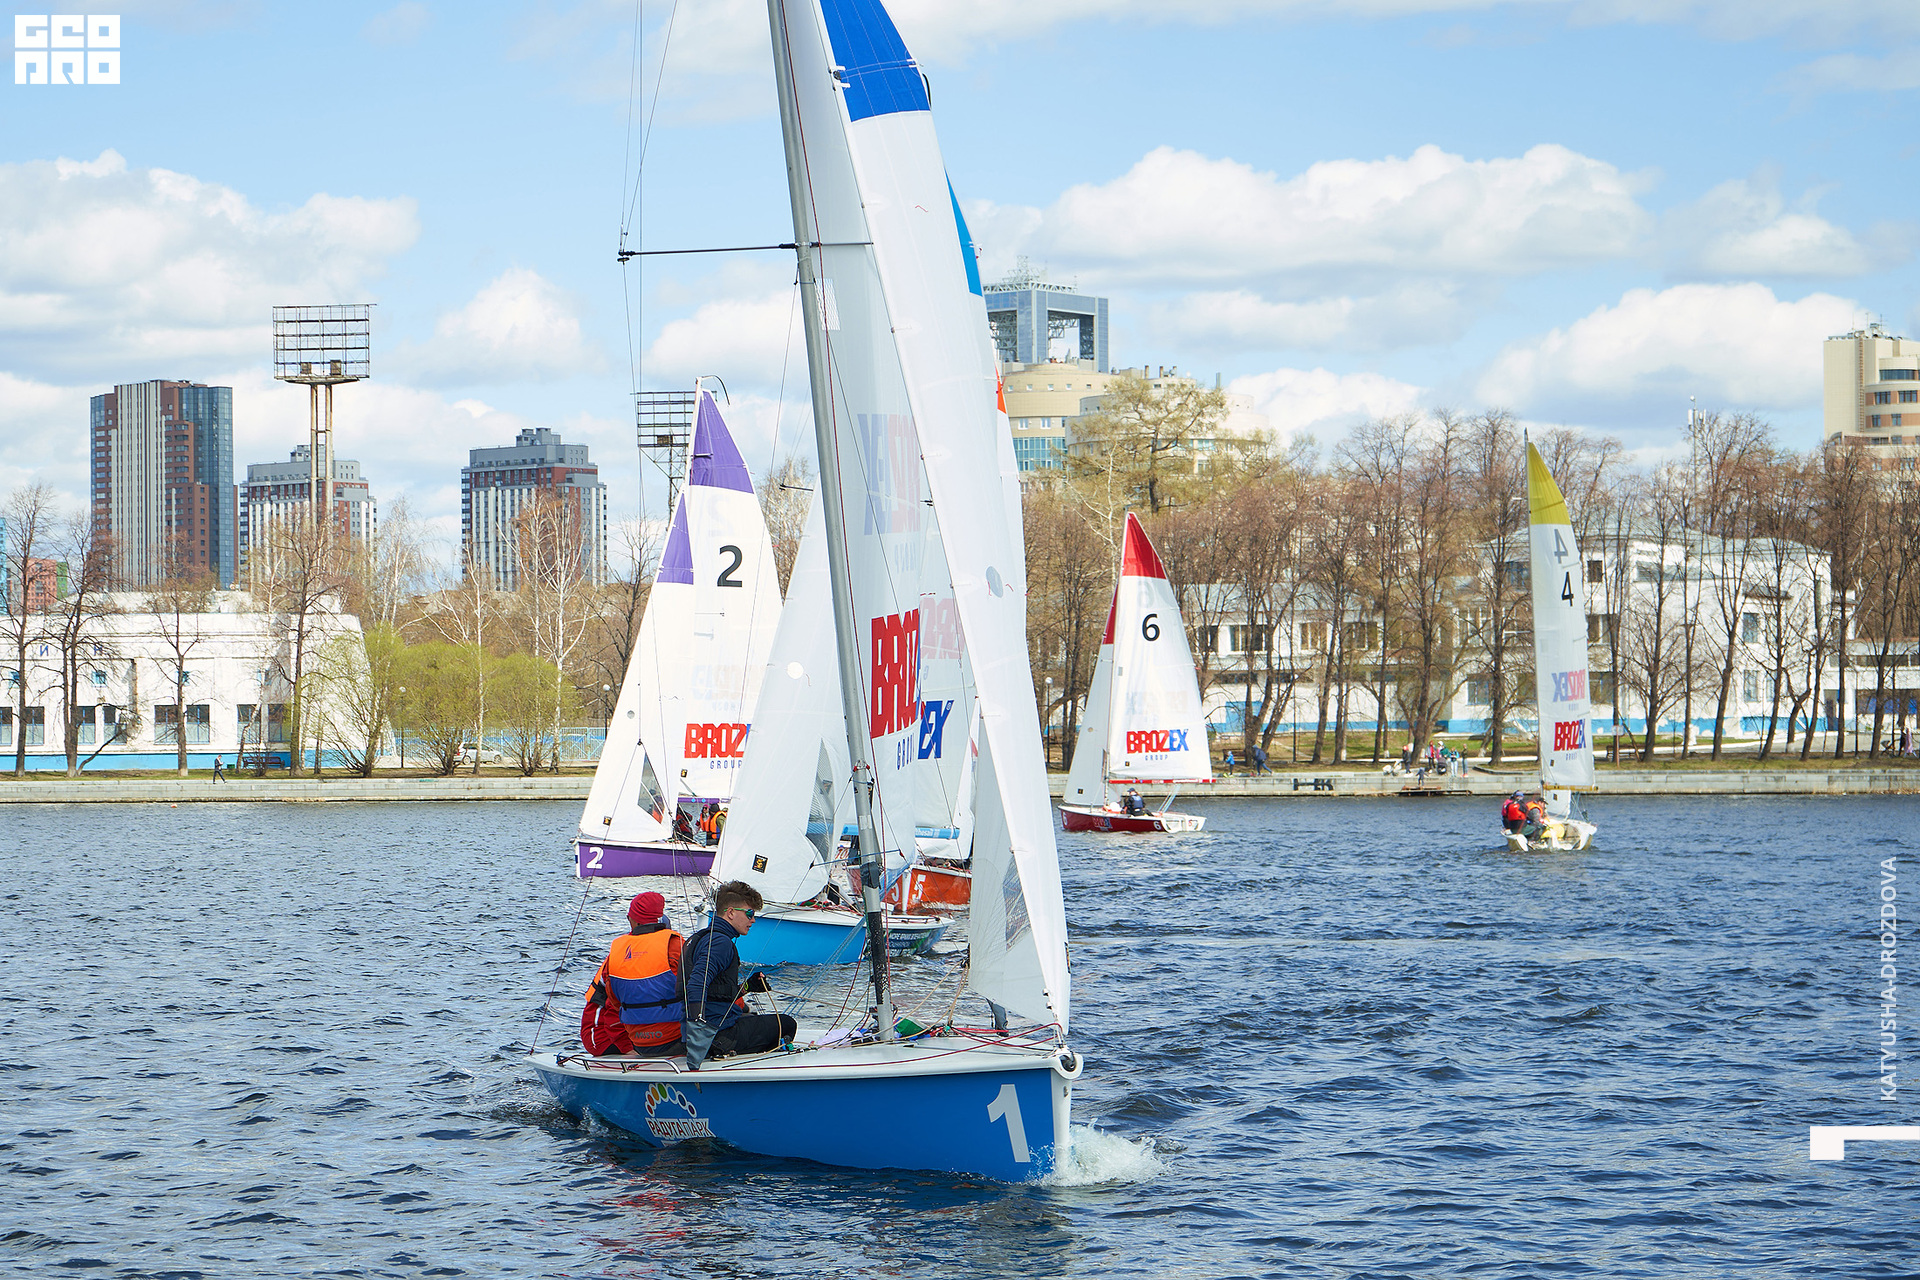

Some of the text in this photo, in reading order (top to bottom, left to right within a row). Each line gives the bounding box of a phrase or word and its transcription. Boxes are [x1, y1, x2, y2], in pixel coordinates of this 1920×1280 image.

[717, 545, 743, 588] 2
[1562, 571, 1575, 607] 4
[1142, 613, 1160, 641] 6
[684, 723, 752, 758] BROZ
[1126, 729, 1189, 754] BROZEX
[1553, 718, 1586, 751] BROZEX
[1154, 820, 1162, 831] 6
[586, 847, 604, 869] 2
[912, 874, 926, 900] 5
[634, 1030, 663, 1039] MUSTO
[987, 1084, 1031, 1162] 1
